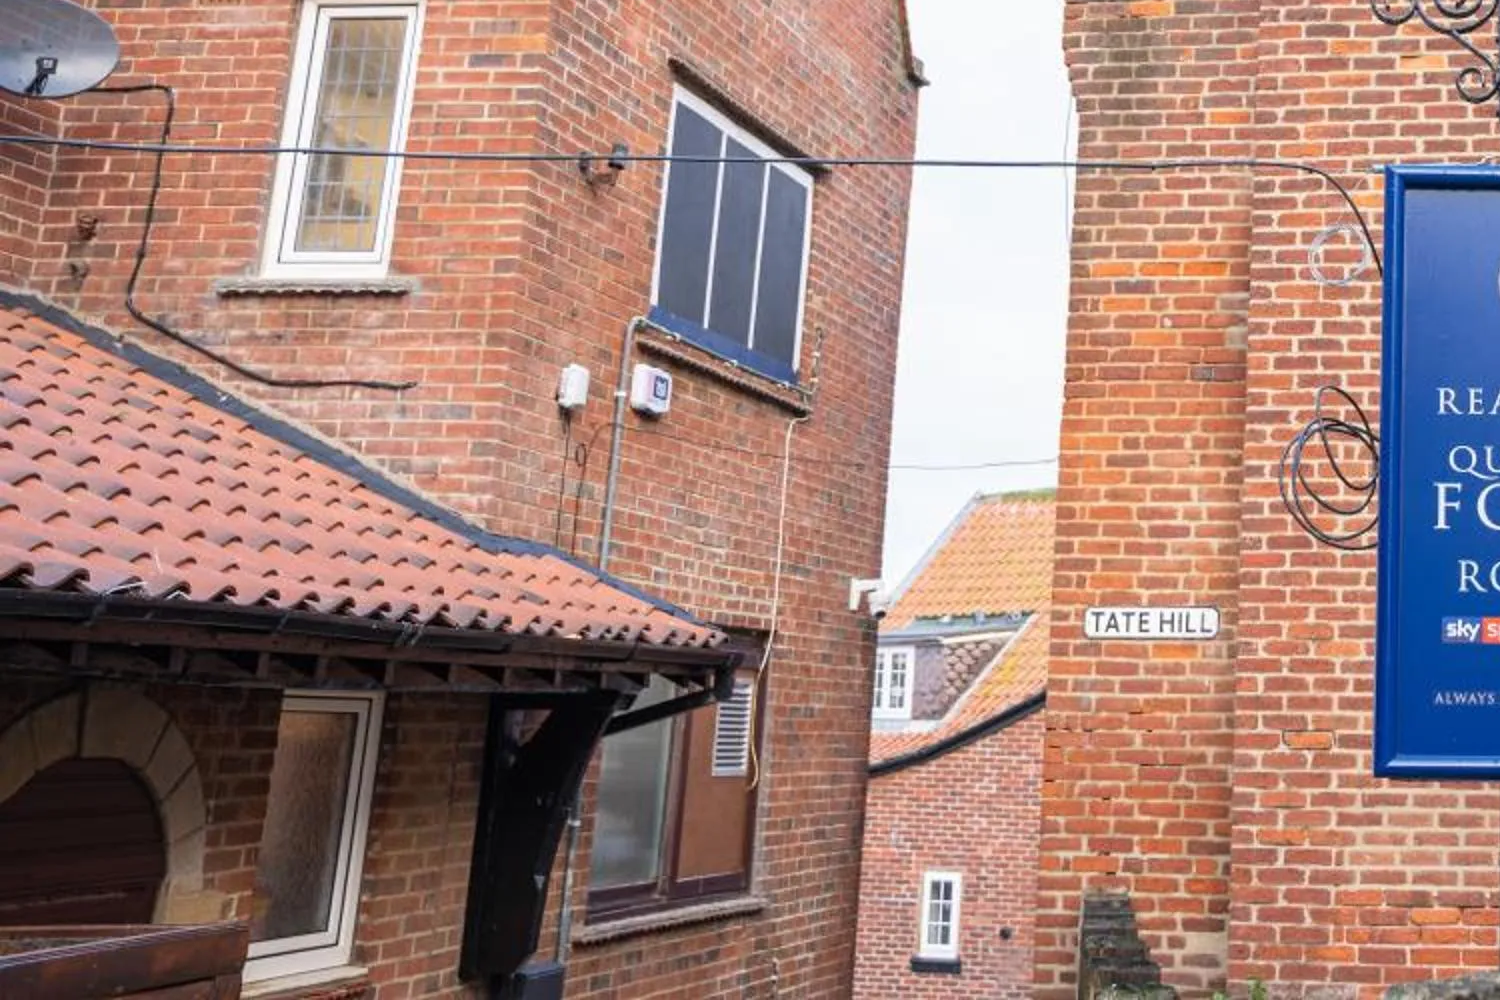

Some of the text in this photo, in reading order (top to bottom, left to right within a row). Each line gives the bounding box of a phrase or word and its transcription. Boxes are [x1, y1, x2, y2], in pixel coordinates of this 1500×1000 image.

[1091, 612, 1213, 633] TATE HILL
[1446, 619, 1480, 641] sky
[1434, 692, 1495, 705] ALWAYS
